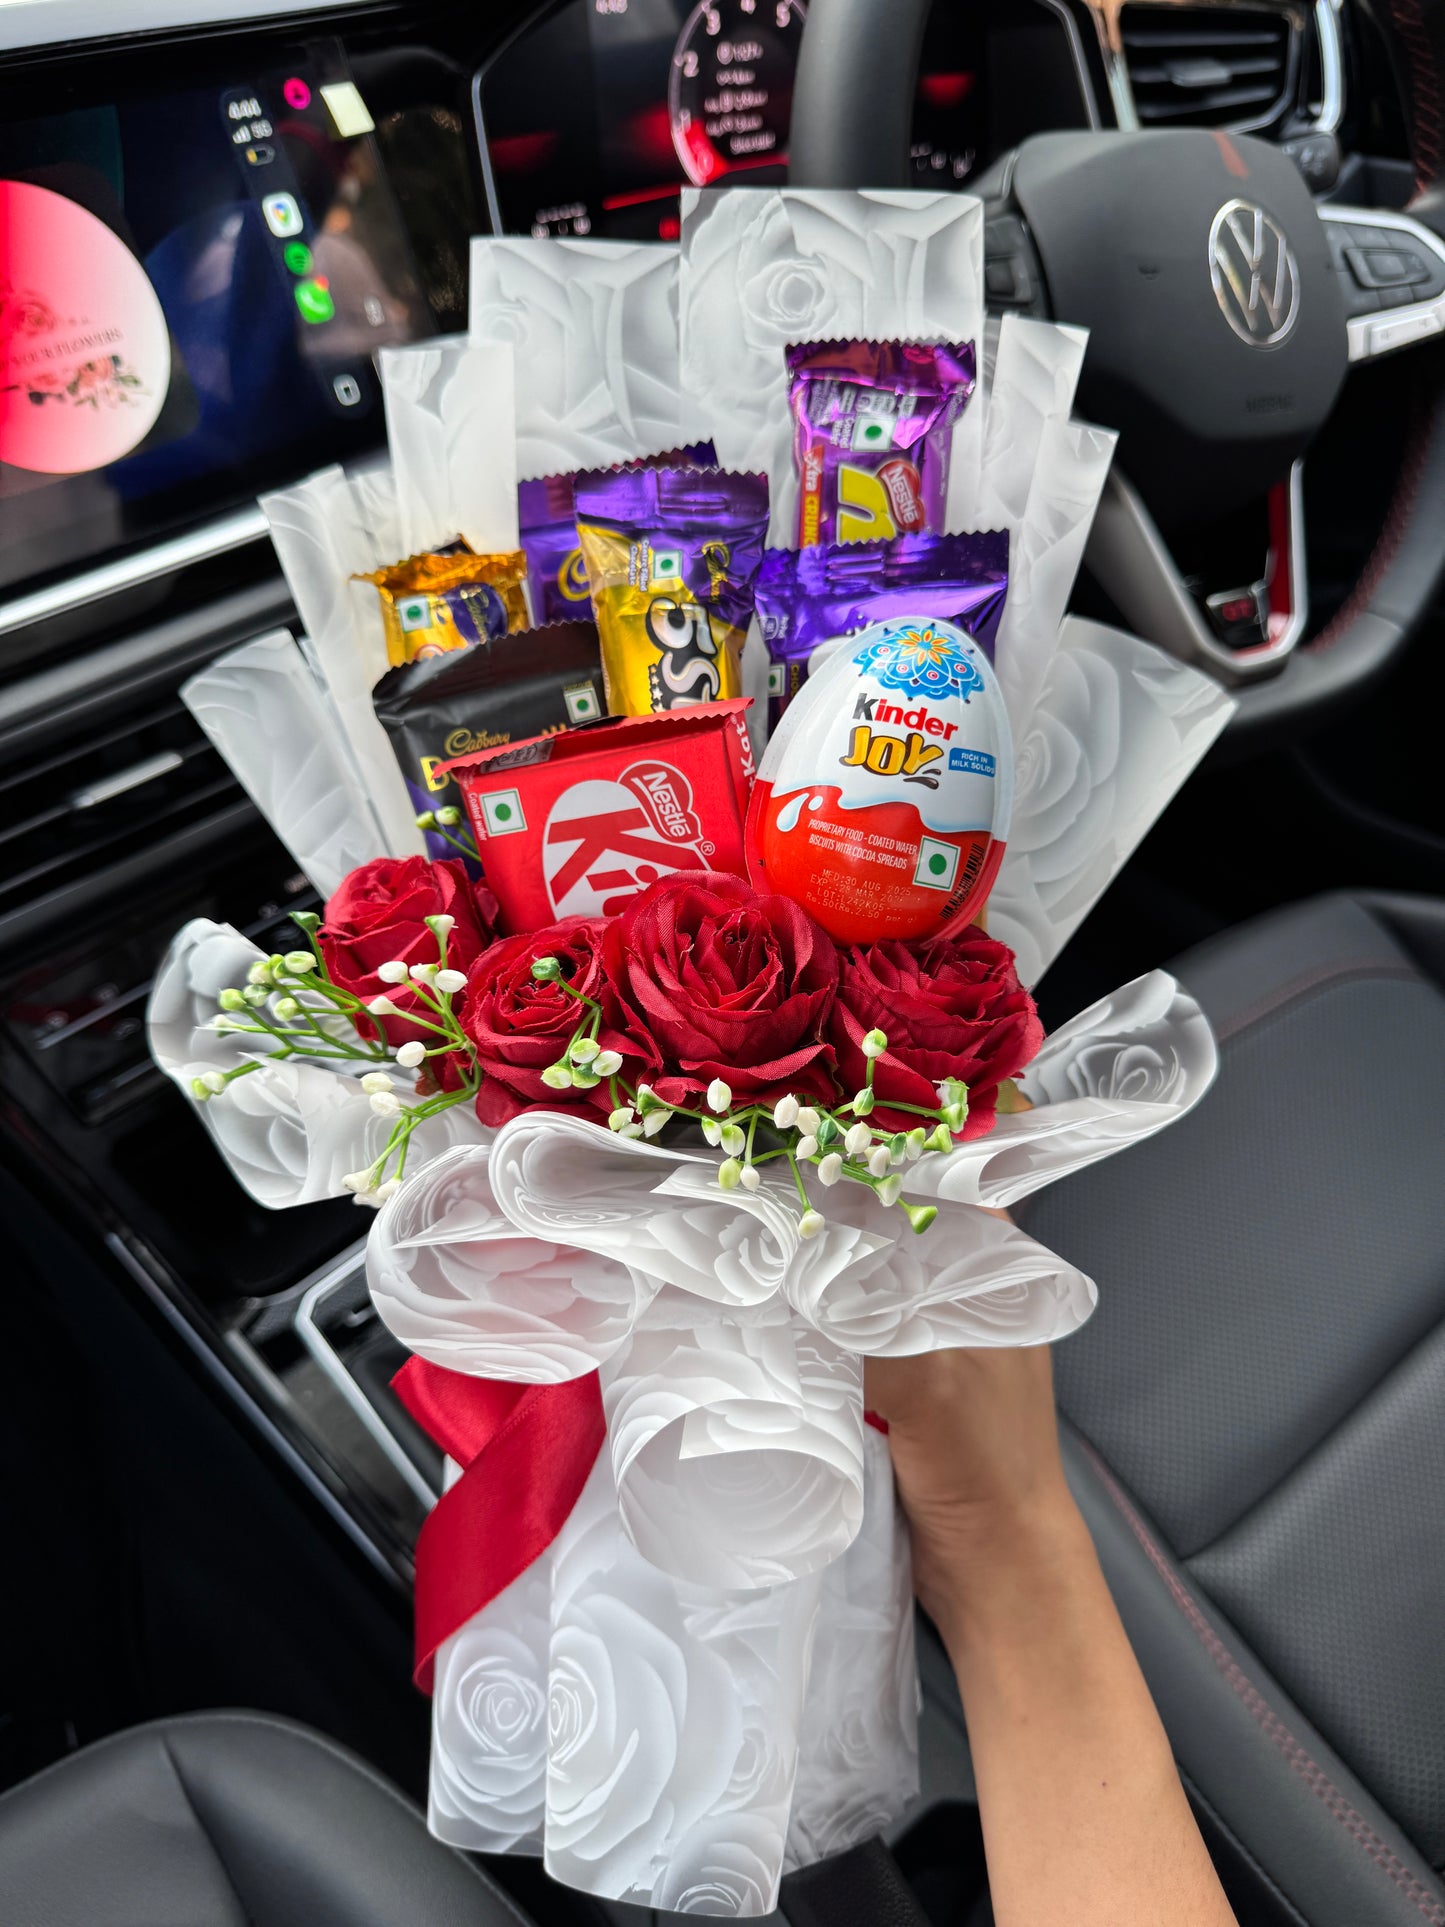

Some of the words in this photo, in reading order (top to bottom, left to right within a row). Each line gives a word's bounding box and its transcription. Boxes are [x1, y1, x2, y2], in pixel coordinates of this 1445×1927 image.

[803, 494, 820, 548] CRUNC
[444, 728, 511, 757] Cadbury
[951, 760, 969, 769] MILK
[961, 752, 978, 763] RICH
[980, 756, 988, 764] IN
[467, 792, 482, 821] Coated
[475, 820, 488, 842] wafer
[808, 818, 845, 836] PROPRIETARY
[845, 827, 863, 842] FOOD
[868, 833, 895, 850] COATED
[895, 839, 918, 856] WAFER
[808, 833, 834, 851] BISCUITS
[834, 841, 852, 856] WITH
[852, 845, 876, 863] COCOA
[876, 852, 907, 870] SPREADS
[856, 888, 874, 900] MAR
[863, 879, 881, 892] AUG
